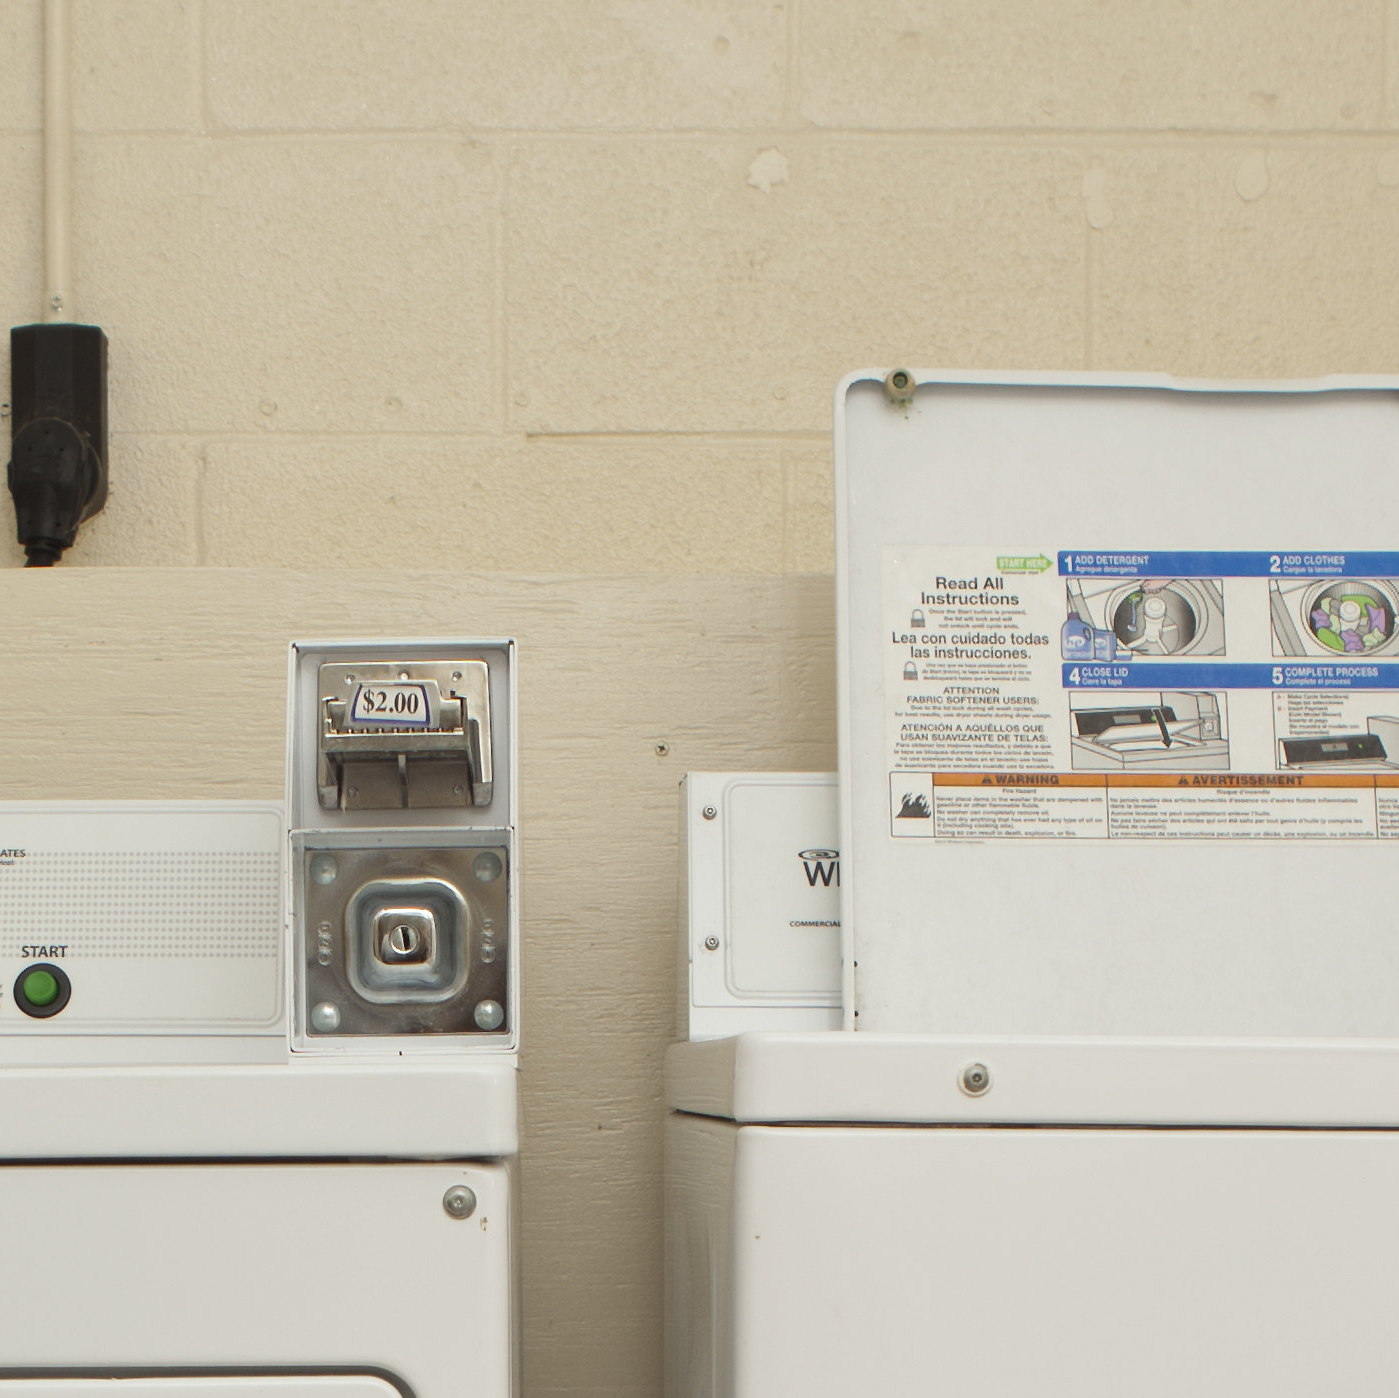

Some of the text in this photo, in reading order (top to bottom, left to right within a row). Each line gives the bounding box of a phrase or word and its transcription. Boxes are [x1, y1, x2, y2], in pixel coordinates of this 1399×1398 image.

[1065, 555, 1149, 572] 1 ADD DETERGENT
[1270, 555, 1345, 573] 2 ADD CLOTHES
[936, 577, 1004, 590] Read All
[922, 592, 1019, 605] Instructions
[892, 632, 1049, 645] Lea con cuidado todas
[911, 646, 1031, 659] las instrucciones.
[1069, 667, 1128, 685] 4 CLOSE LID
[1272, 667, 1378, 685] 5 COMPLETE PROCESS
[943, 687, 999, 695] ATTENTION
[363, 689, 419, 714] $2.00
[901, 733, 1048, 742] USAN SUAVIZANTE DE TELAS:
[995, 775, 1059, 785] WARNING
[1192, 775, 1304, 786] AVERTISSEMENT
[21, 945, 68, 958] START
